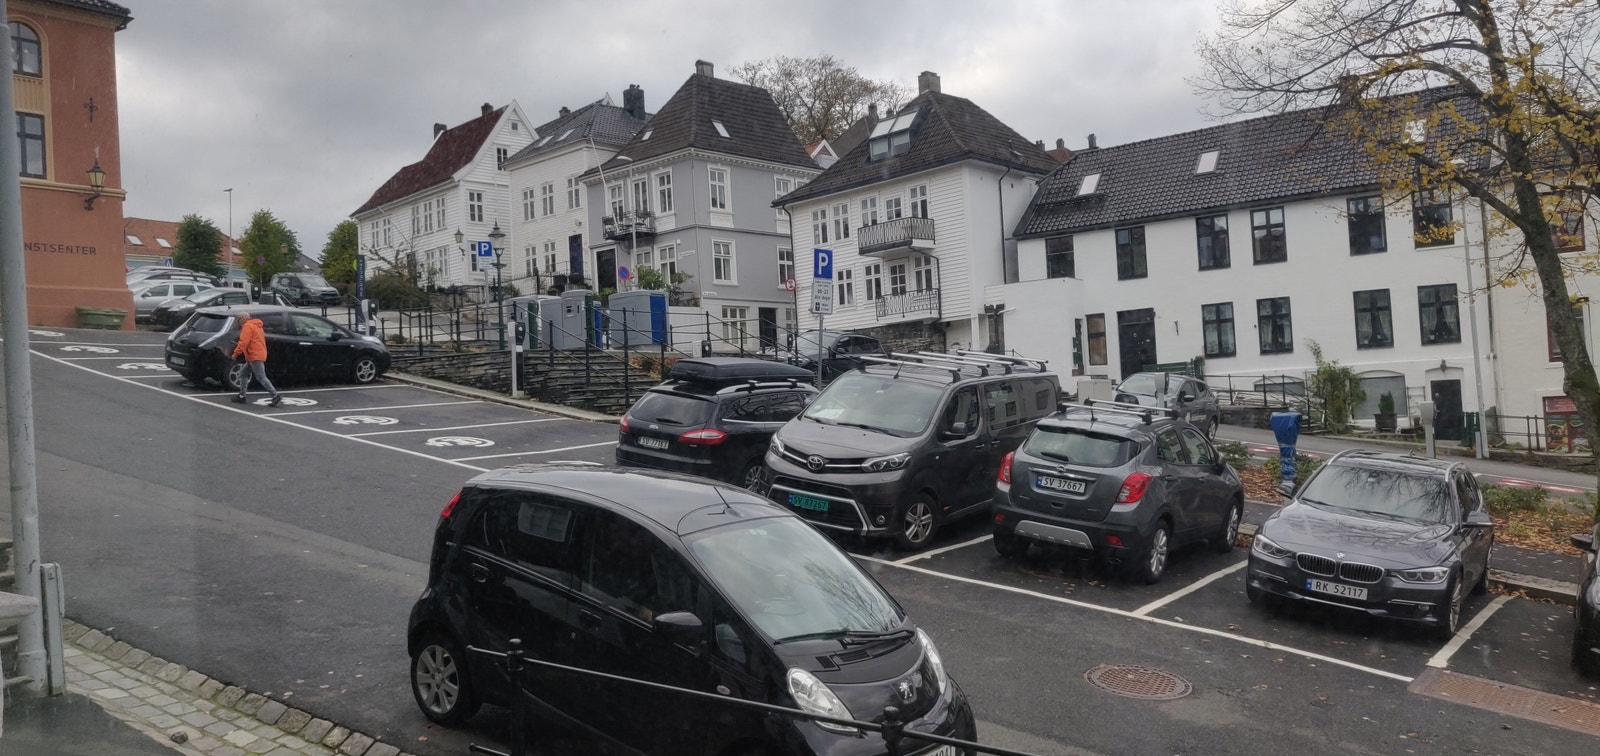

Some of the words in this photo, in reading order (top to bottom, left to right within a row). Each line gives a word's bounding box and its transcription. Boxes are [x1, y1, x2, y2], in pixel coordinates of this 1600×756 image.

[482, 243, 489, 255] P
[818, 252, 829, 275] P
[1044, 477, 1055, 486] SV
[1057, 479, 1083, 491] 37667
[793, 495, 803, 504] SV
[804, 498, 827, 510] 87267
[1315, 580, 1329, 592] RK
[1334, 584, 1364, 598] 52117
